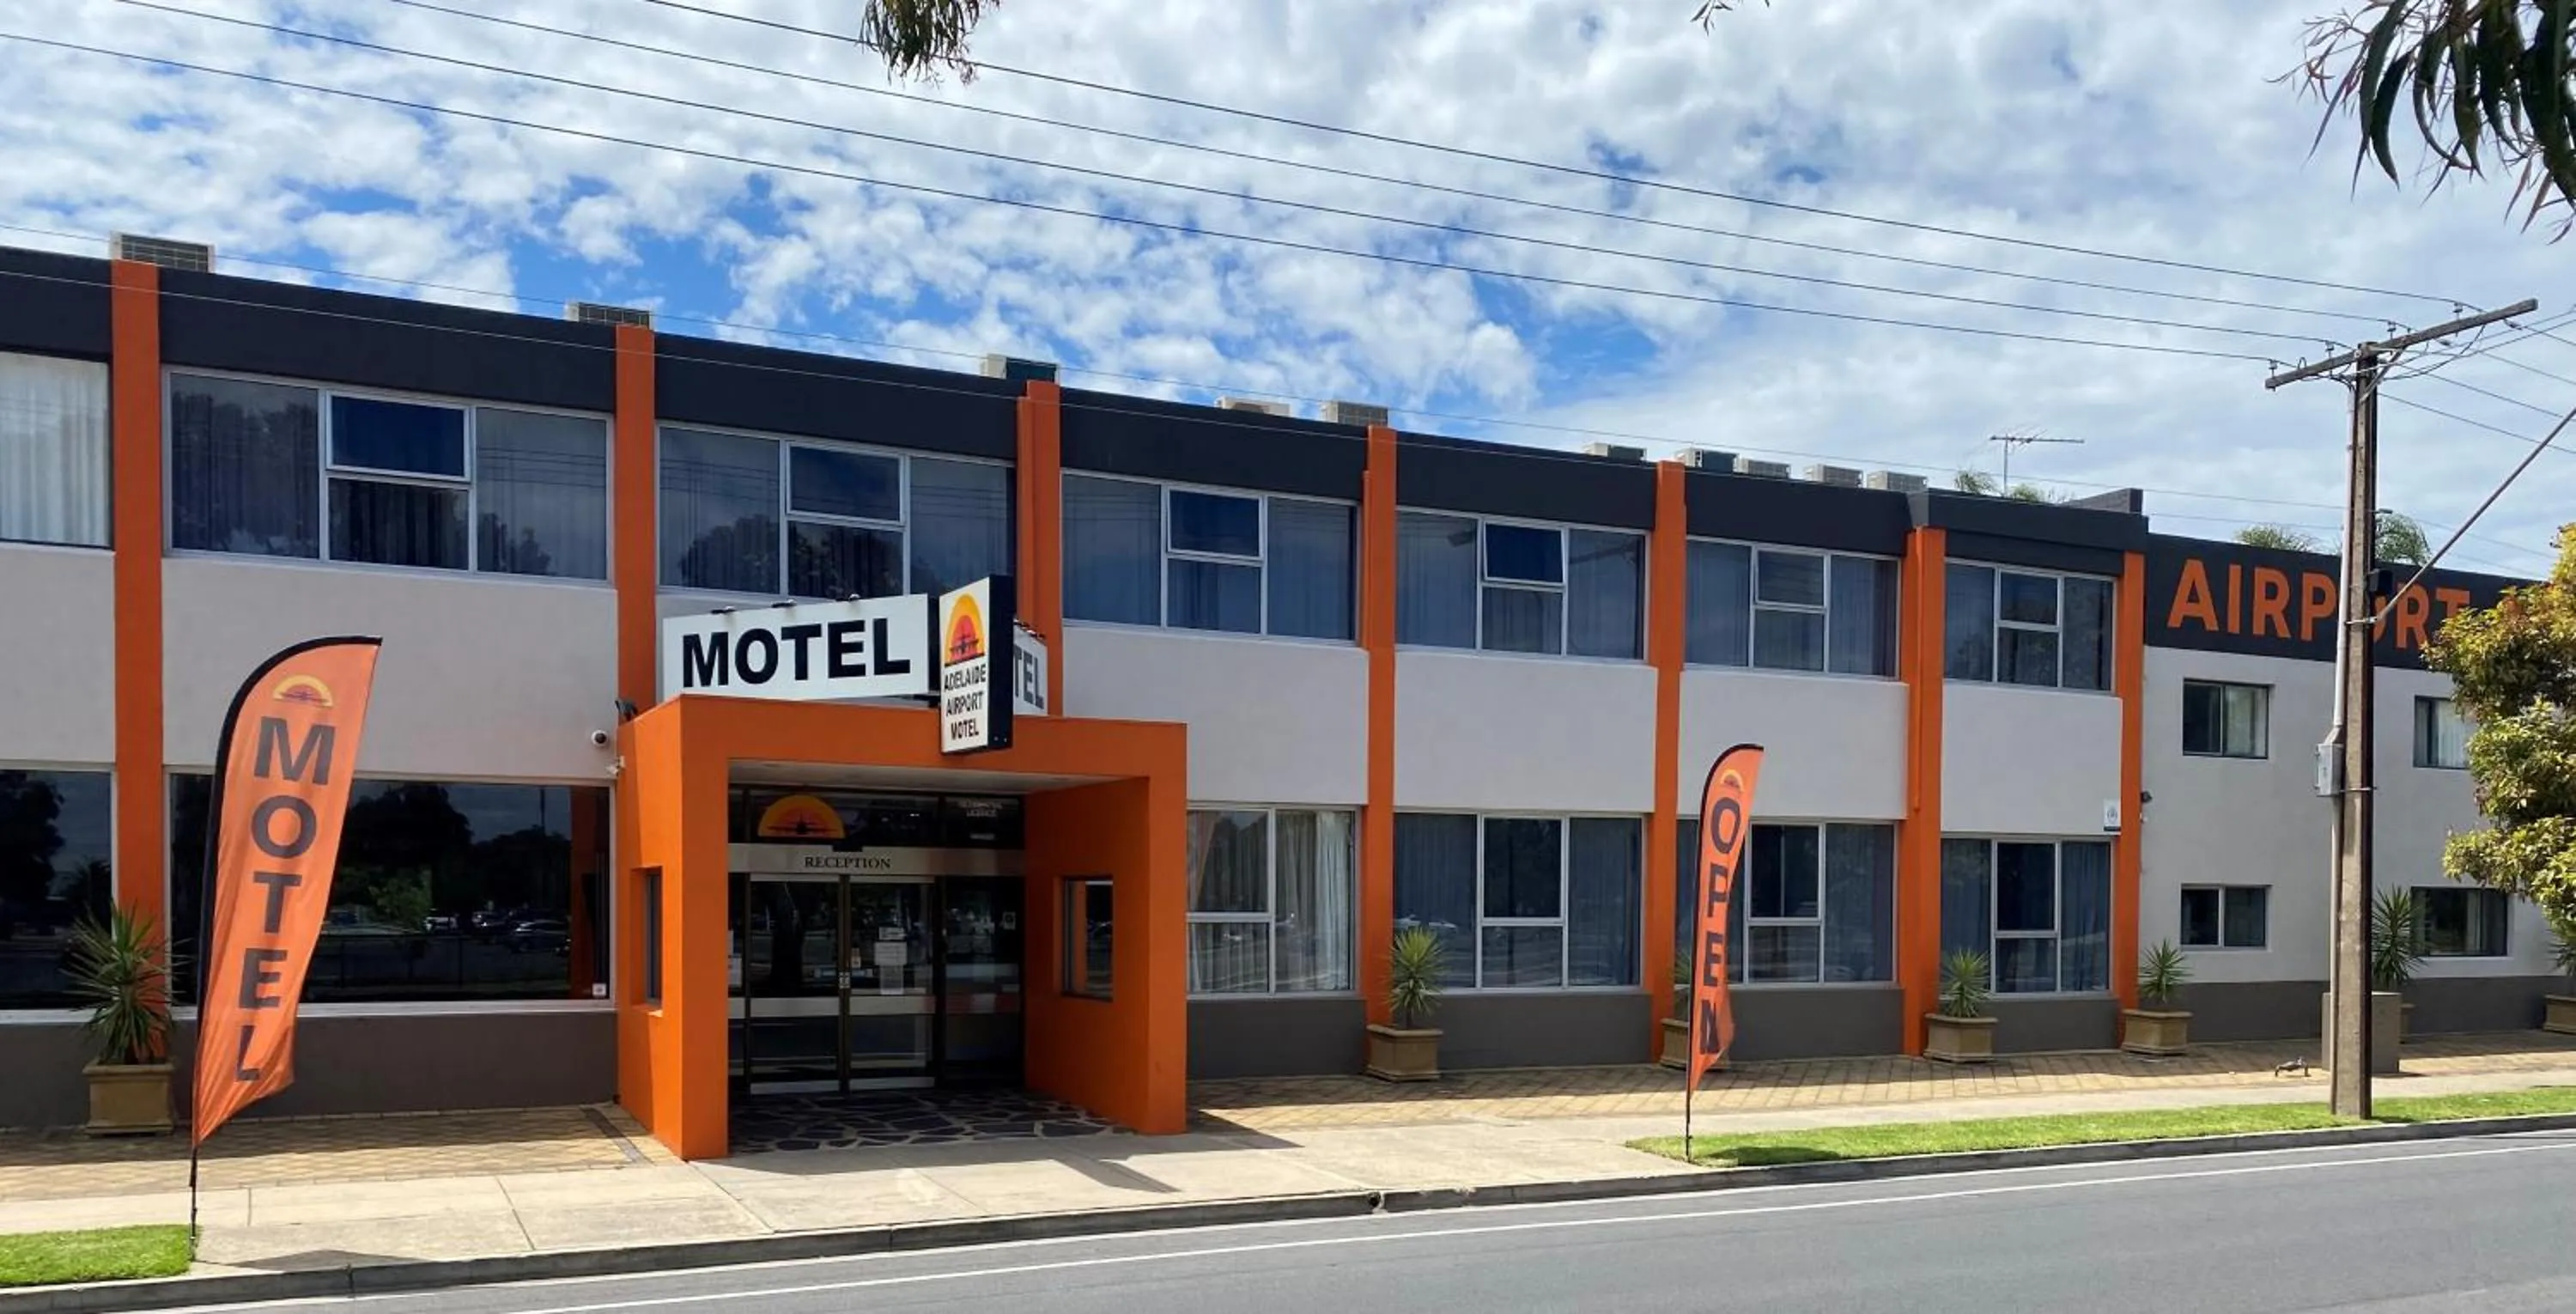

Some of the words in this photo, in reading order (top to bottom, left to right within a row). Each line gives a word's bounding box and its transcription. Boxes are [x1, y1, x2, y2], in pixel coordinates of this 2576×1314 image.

[2168, 559, 2470, 650] AIRPRT
[683, 617, 910, 687] MOTEL
[945, 664, 987, 691] ADELAIDE
[1014, 644, 1044, 709] TEL
[945, 691, 984, 716] AIRPORT
[951, 718, 979, 739] MOTEL
[805, 856, 890, 868] RECEPTION
[234, 716, 336, 1080] MOTEL
[1701, 797, 1741, 1055] OPEN
